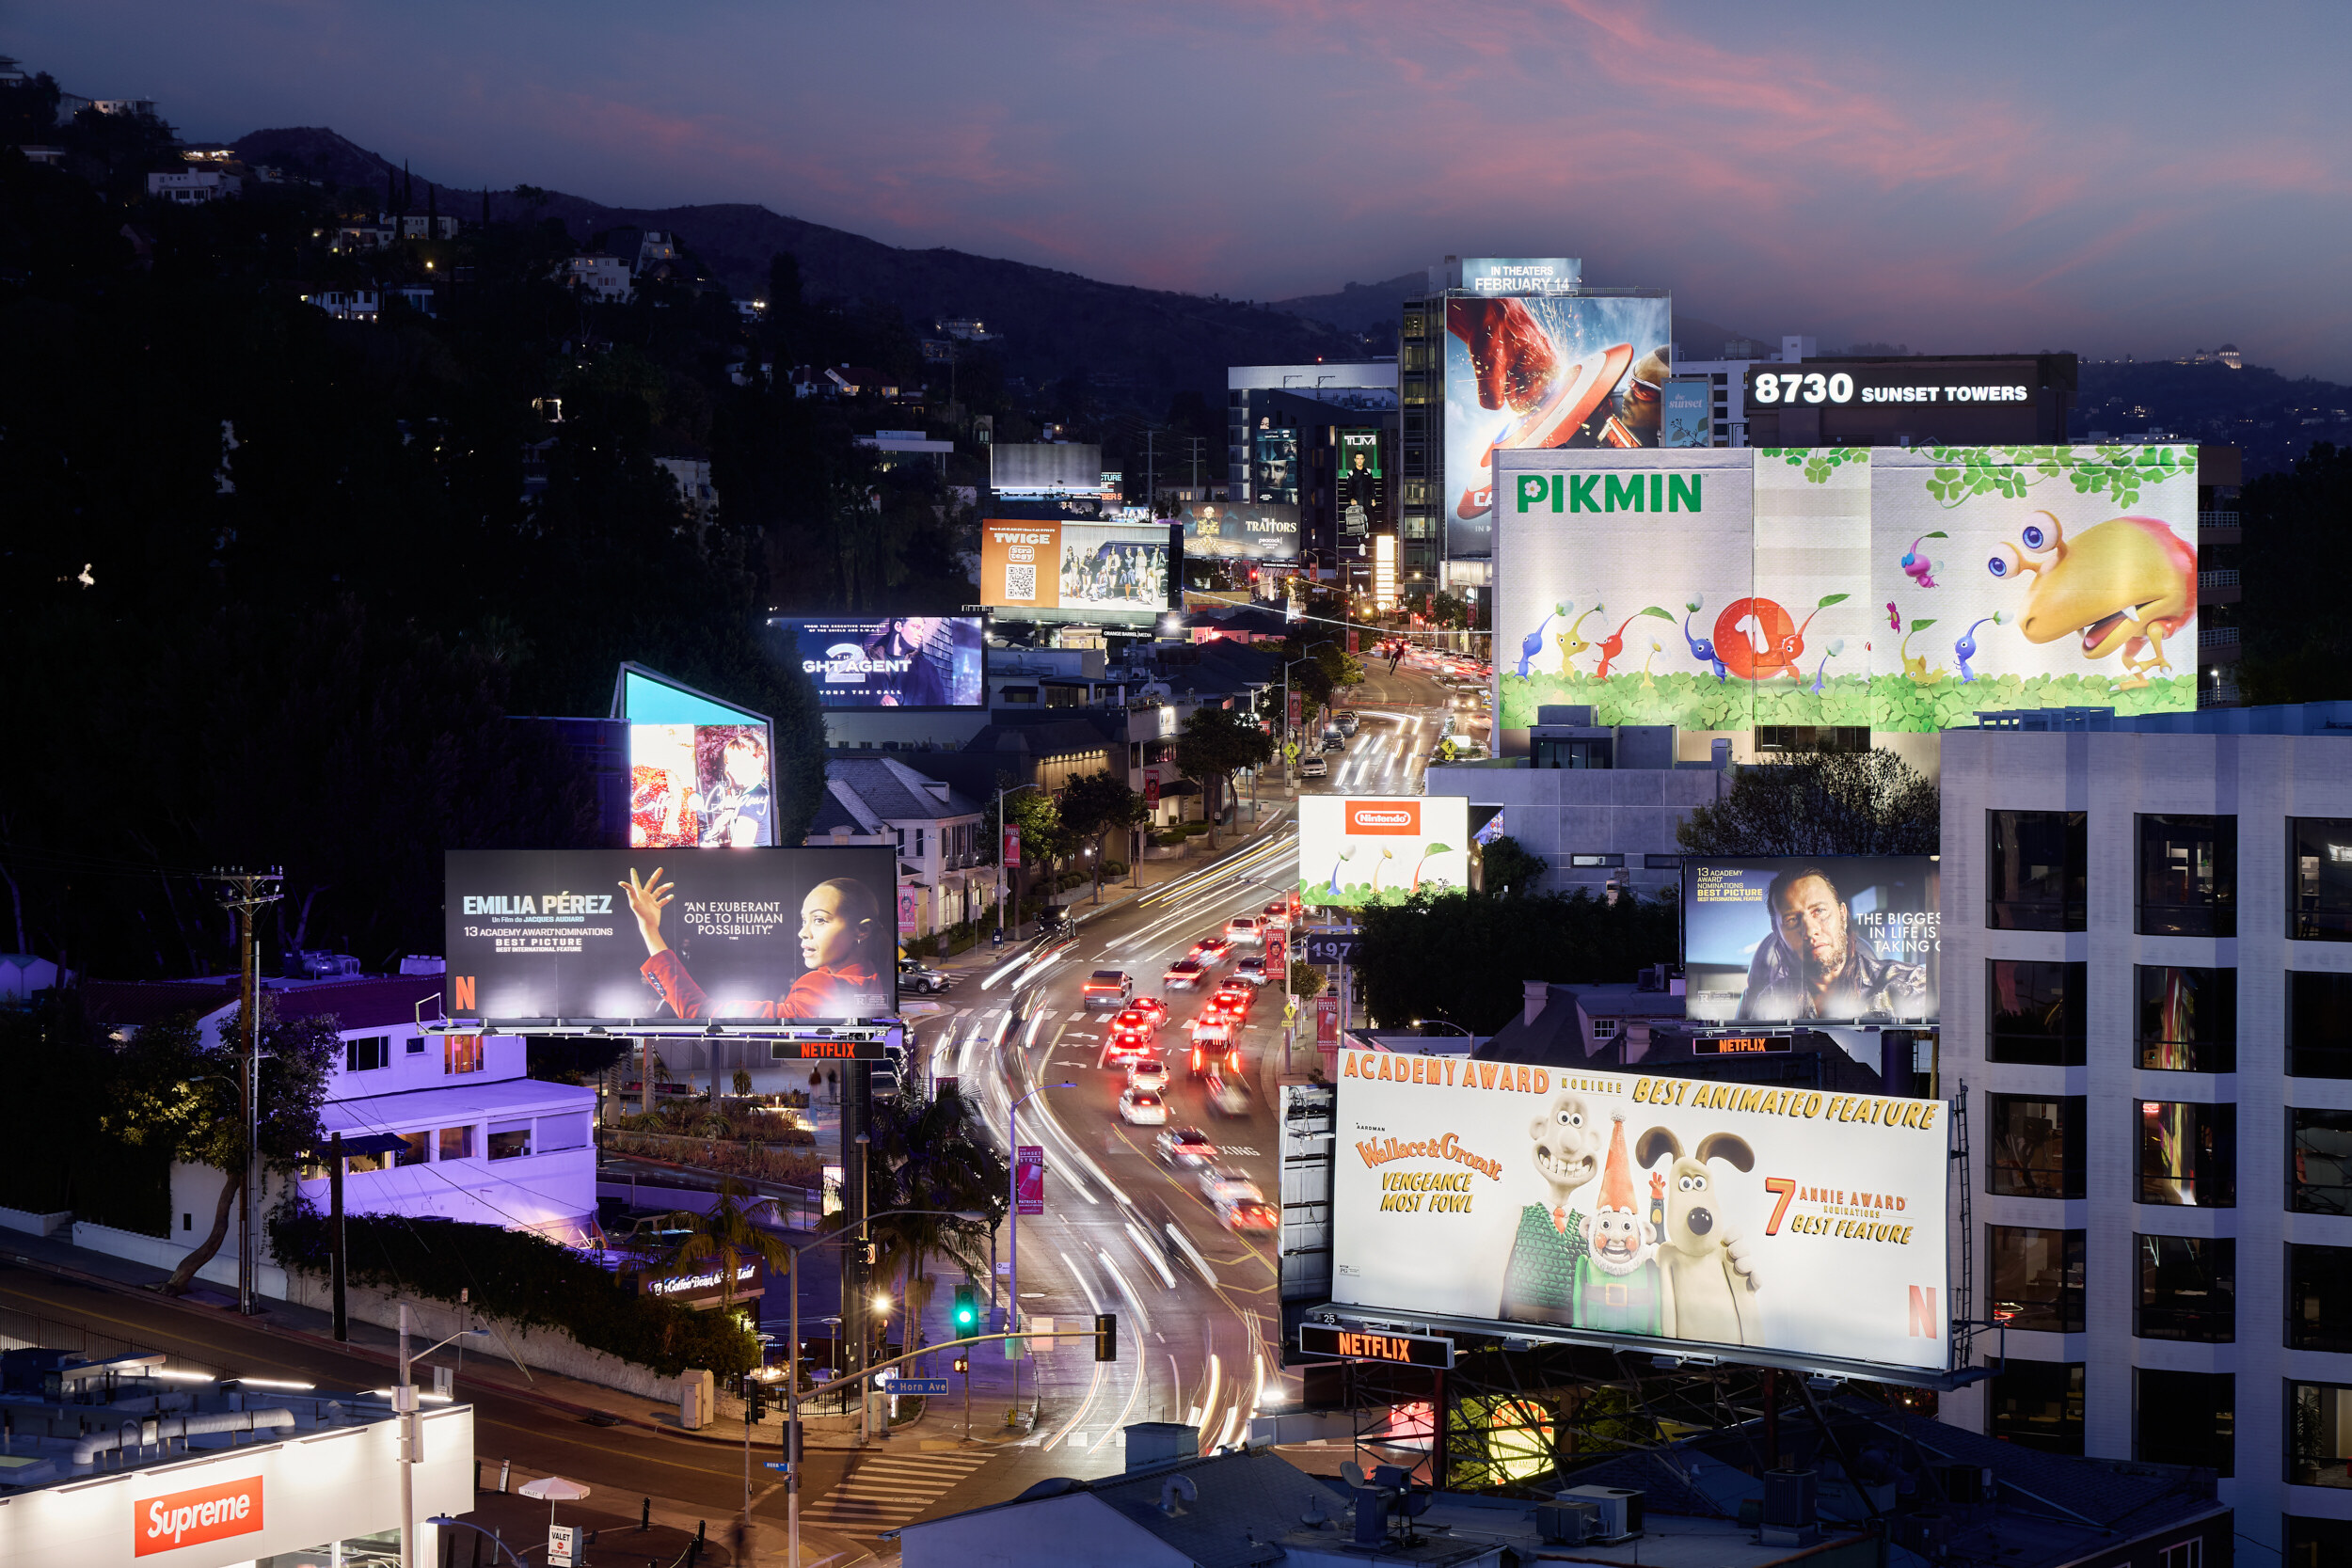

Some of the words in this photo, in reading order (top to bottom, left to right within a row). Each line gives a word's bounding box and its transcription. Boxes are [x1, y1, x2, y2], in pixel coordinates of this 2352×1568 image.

[1491, 266, 1501, 276] IN
[1502, 266, 1553, 276] THEATERS
[1475, 278, 1550, 291] FEBRUARY
[1554, 278, 1569, 291] 14
[1755, 373, 1853, 403] 8730
[1861, 387, 1939, 403] SUNSET
[1945, 387, 2027, 402] TOWERS
[1669, 399, 1702, 408] sunset
[1344, 435, 1375, 445] TUMI
[1518, 474, 1702, 514] PIKMIN
[1246, 518, 1296, 533] TRAITORS
[994, 532, 1050, 544] TWICE
[803, 660, 844, 673] GHT
[846, 660, 912, 673] AGENT
[825, 643, 866, 683] 2
[1360, 814, 1406, 823] Nintendo
[1697, 867, 1708, 877] 13
[464, 896, 536, 914] EMILIA
[542, 891, 612, 914] PÉREZ
[710, 902, 780, 911] EXUBERANT
[684, 913, 710, 923] ODE
[715, 913, 731, 923] TO
[736, 913, 783, 923] HUMAN
[1856, 912, 1882, 925] THE
[464, 927, 477, 936] 13
[1869, 927, 1884, 939] IN
[1891, 927, 1917, 939] LIFE
[1924, 927, 1936, 938] IS
[532, 938, 582, 946] PICTURE
[1874, 941, 1930, 953] TAKING
[456, 976, 475, 1010] N
[801, 1043, 855, 1058] NETFLIX
[1719, 1038, 1766, 1053] NETFLIX
[1344, 1053, 1456, 1085] ACADEMY
[1463, 1062, 1549, 1094] AWARD
[1562, 1078, 1622, 1093] NOMINEE
[1632, 1077, 1691, 1105] BEST
[1692, 1084, 1822, 1118] ANIMATED
[1826, 1096, 1939, 1130] FEATURE
[1357, 1123, 1386, 1132] AARDMAN
[1216, 1145, 1261, 1157] XING
[1382, 1172, 1474, 1192] VENGEANCE
[1379, 1193, 1425, 1212] MOST
[1428, 1194, 1474, 1212] FOWL
[1799, 1186, 1844, 1204] ANNIE
[1851, 1192, 1906, 1211] AWARD
[1765, 1177, 1796, 1236] 7
[1823, 1205, 1880, 1218] NOMINATIONS
[1791, 1214, 1835, 1235] BEST
[1835, 1219, 1914, 1244] FEATURE
[668, 1279, 691, 1292] Coffee
[691, 1276, 714, 1289] Bean
[737, 1265, 755, 1279] Leaf
[1324, 1314, 1335, 1323] 25
[1909, 1285, 1938, 1339] N
[1339, 1332, 1410, 1363] NETFLIX
[900, 1383, 923, 1391] Horn
[929, 1383, 946, 1391] Ave
[148, 1494, 250, 1544] Supreme
[551, 1532, 570, 1542] VALET
